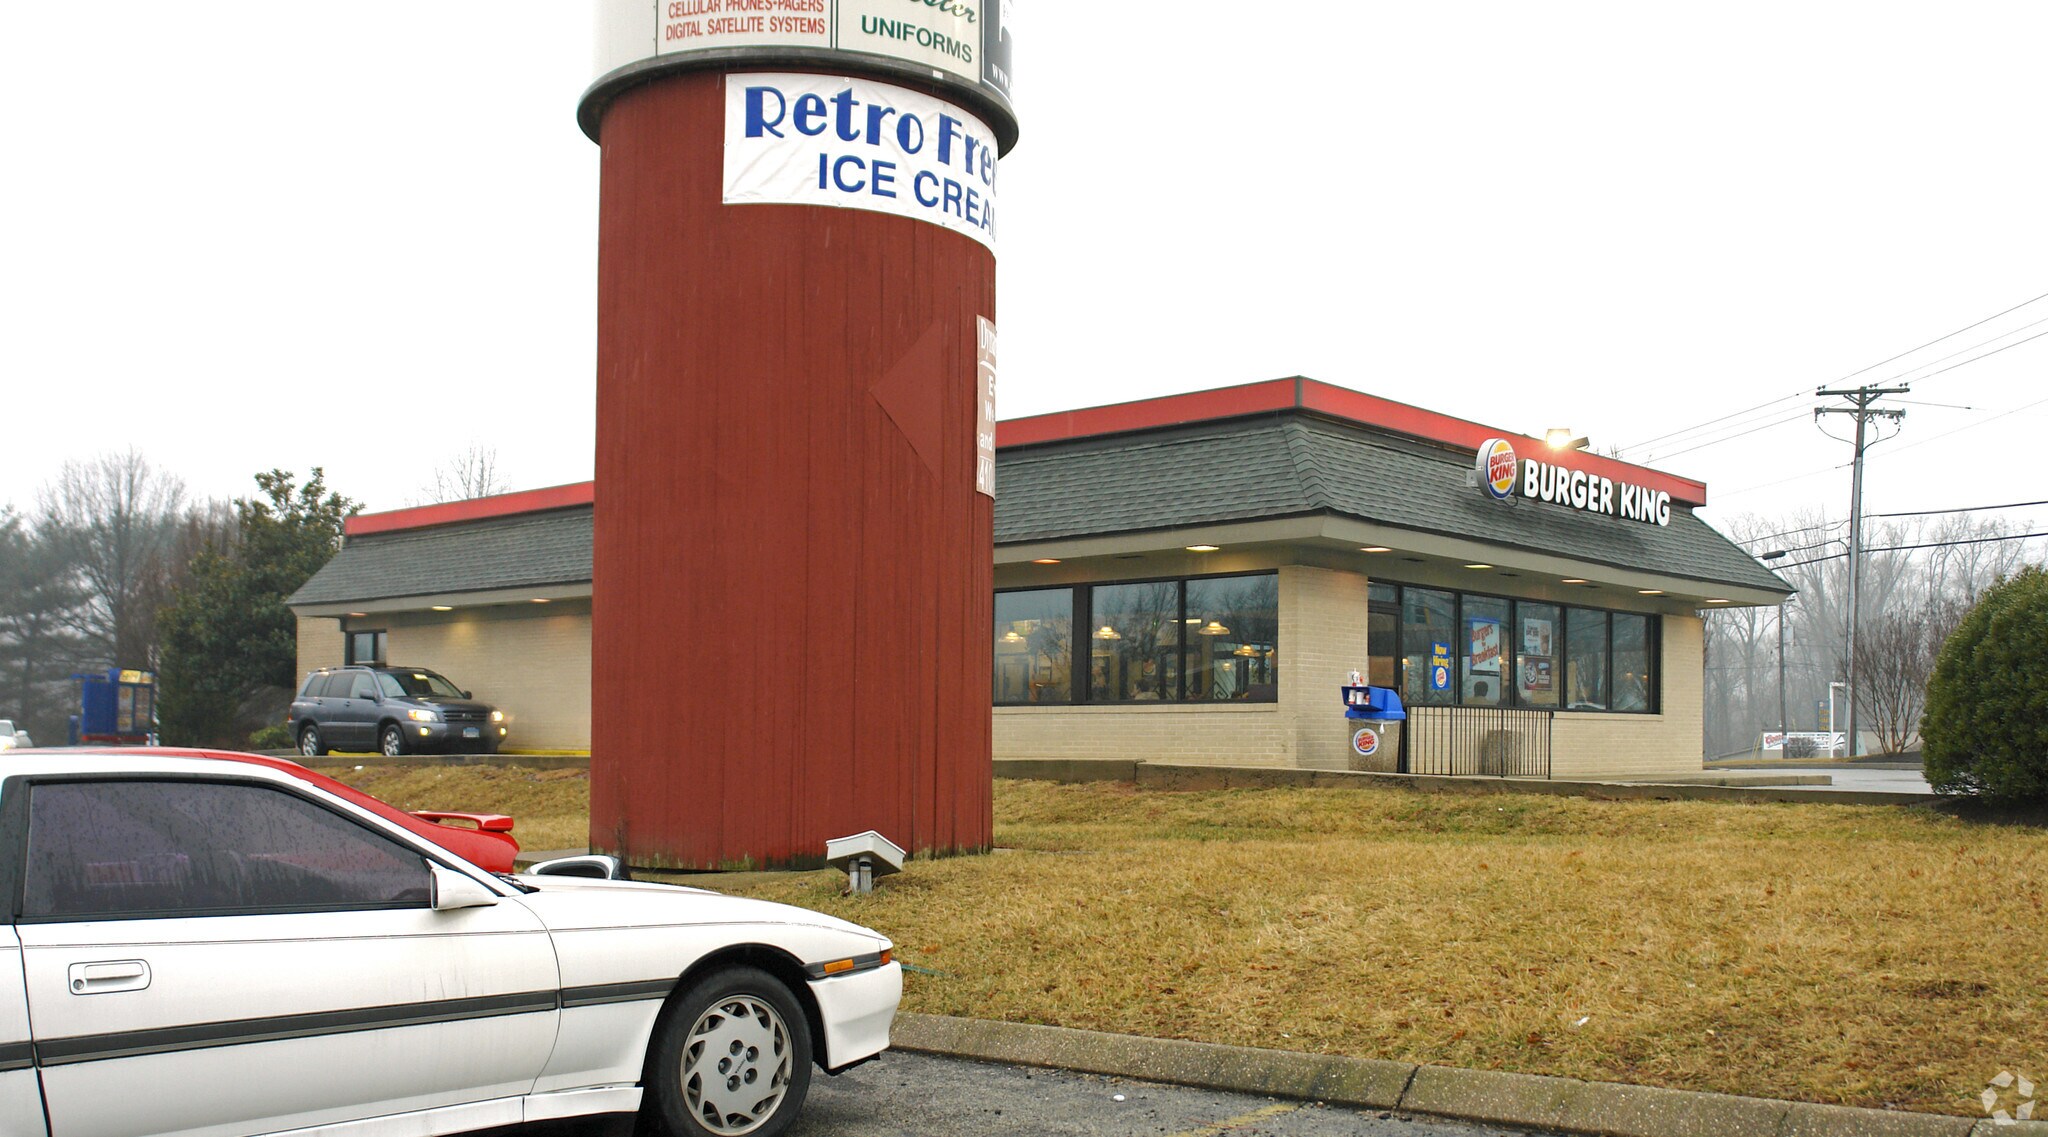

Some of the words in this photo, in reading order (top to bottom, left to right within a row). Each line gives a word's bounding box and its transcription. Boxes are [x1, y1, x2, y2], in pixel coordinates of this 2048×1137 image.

[668, 0, 721, 19] CELLULAR
[666, 21, 703, 41] DIGITAL
[707, 16, 764, 35] SATELLITE
[769, 16, 825, 35] SYSTEMS
[861, 14, 973, 64] UNIFORMS
[744, 85, 924, 155] Retro
[819, 152, 897, 199] ICE
[1490, 450, 1515, 468] BURGER
[1490, 463, 1515, 484] KING
[1523, 458, 1614, 515] BURGER
[1620, 481, 1671, 527] KING
